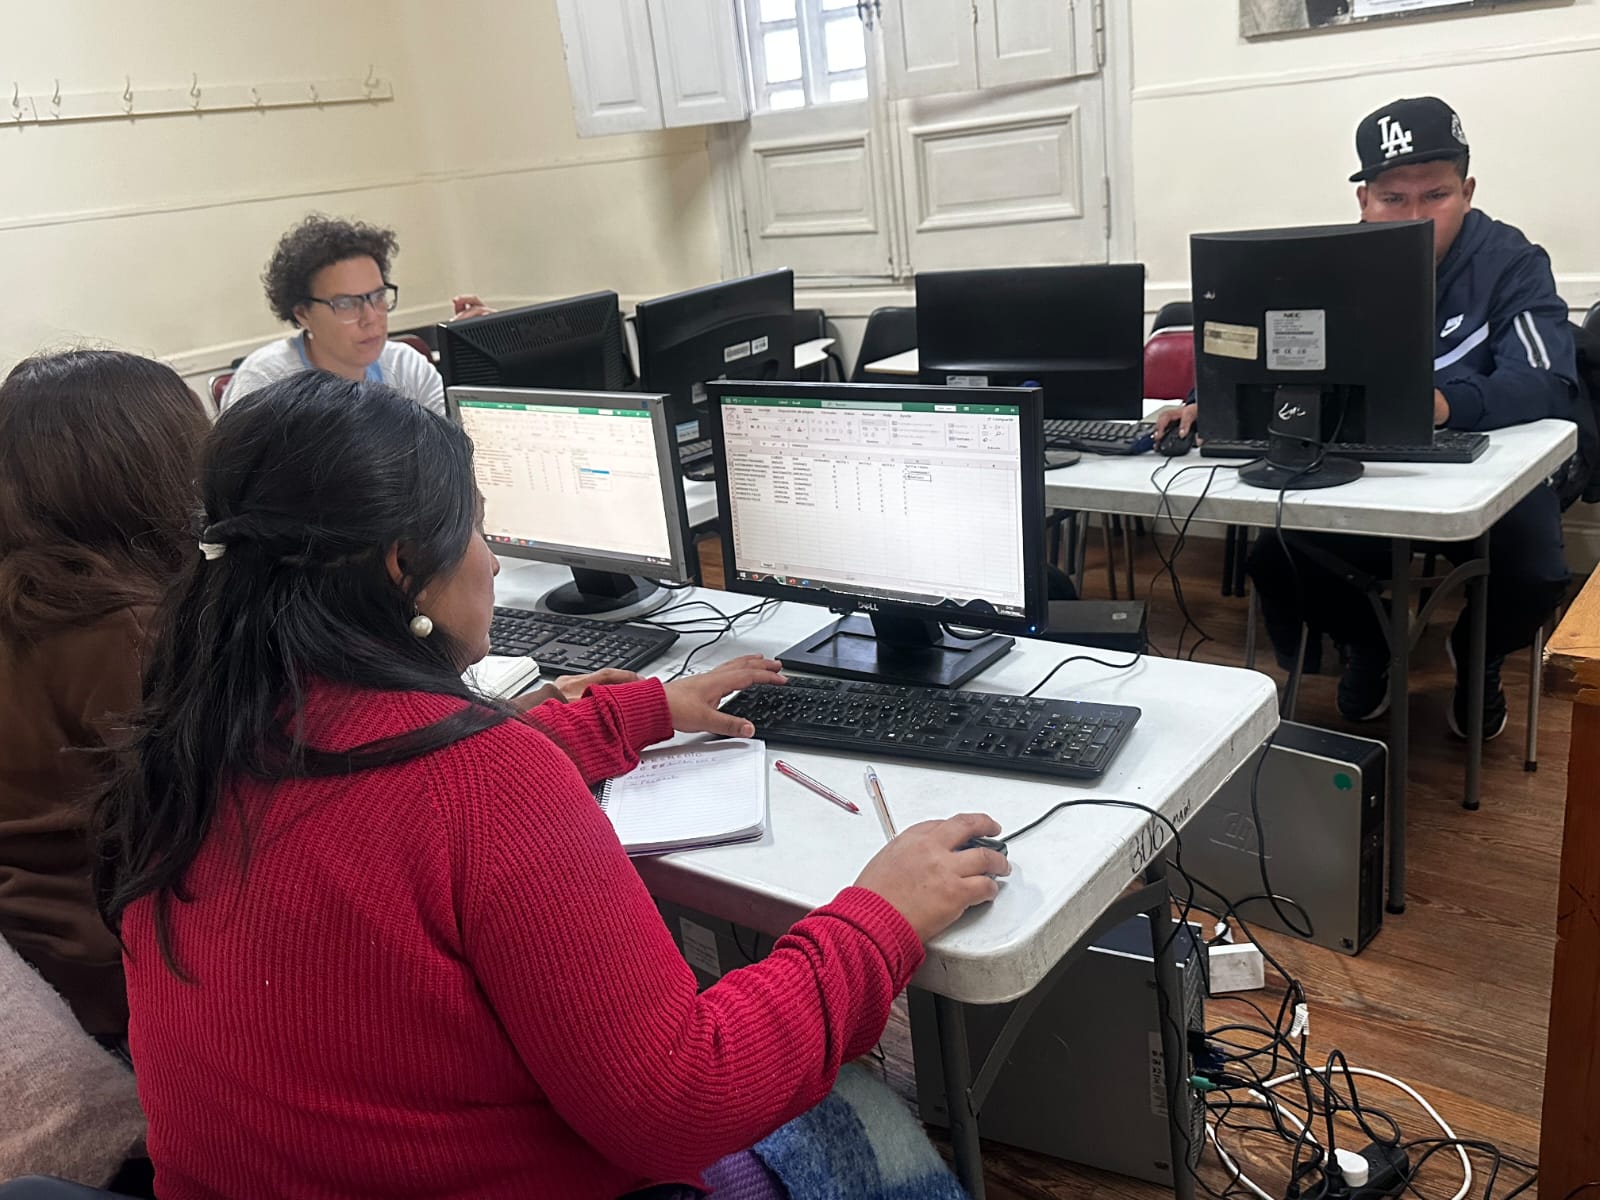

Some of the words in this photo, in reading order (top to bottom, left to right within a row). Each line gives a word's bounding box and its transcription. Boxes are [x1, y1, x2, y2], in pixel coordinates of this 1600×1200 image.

[1377, 115, 1414, 159] LA
[857, 600, 879, 611] DELL
[1131, 813, 1164, 874] 306
